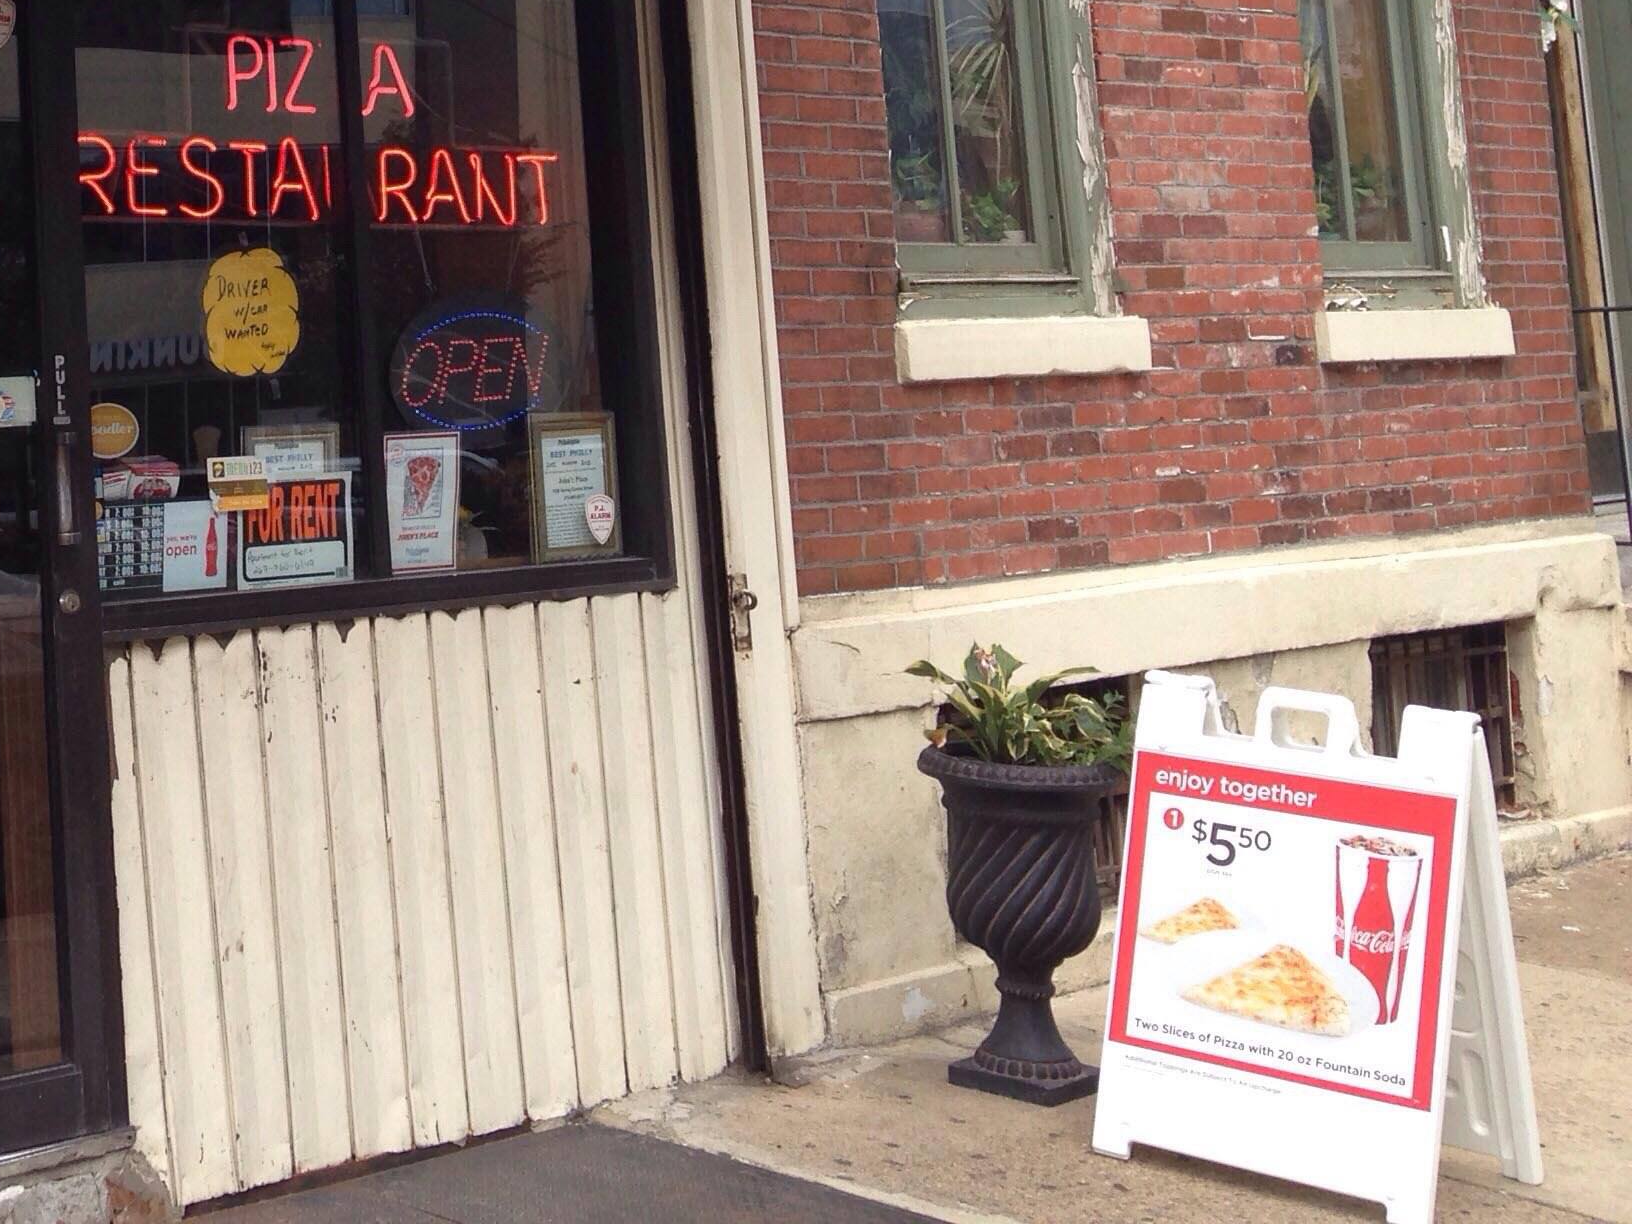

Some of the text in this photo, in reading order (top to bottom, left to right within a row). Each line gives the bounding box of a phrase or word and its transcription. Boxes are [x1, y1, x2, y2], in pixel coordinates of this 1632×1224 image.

[226, 35, 414, 117] PIZA
[216, 277, 269, 302] DRIVER
[54, 355, 66, 415] PULL
[402, 334, 549, 407] OPEN
[247, 487, 285, 543] FOR
[291, 483, 340, 541] RENT
[165, 544, 197, 559] open
[1155, 767, 1318, 809] enjoy together
[1134, 1018, 1406, 1087] Two Slices of Pizza with 20 oz Fountain Soda
